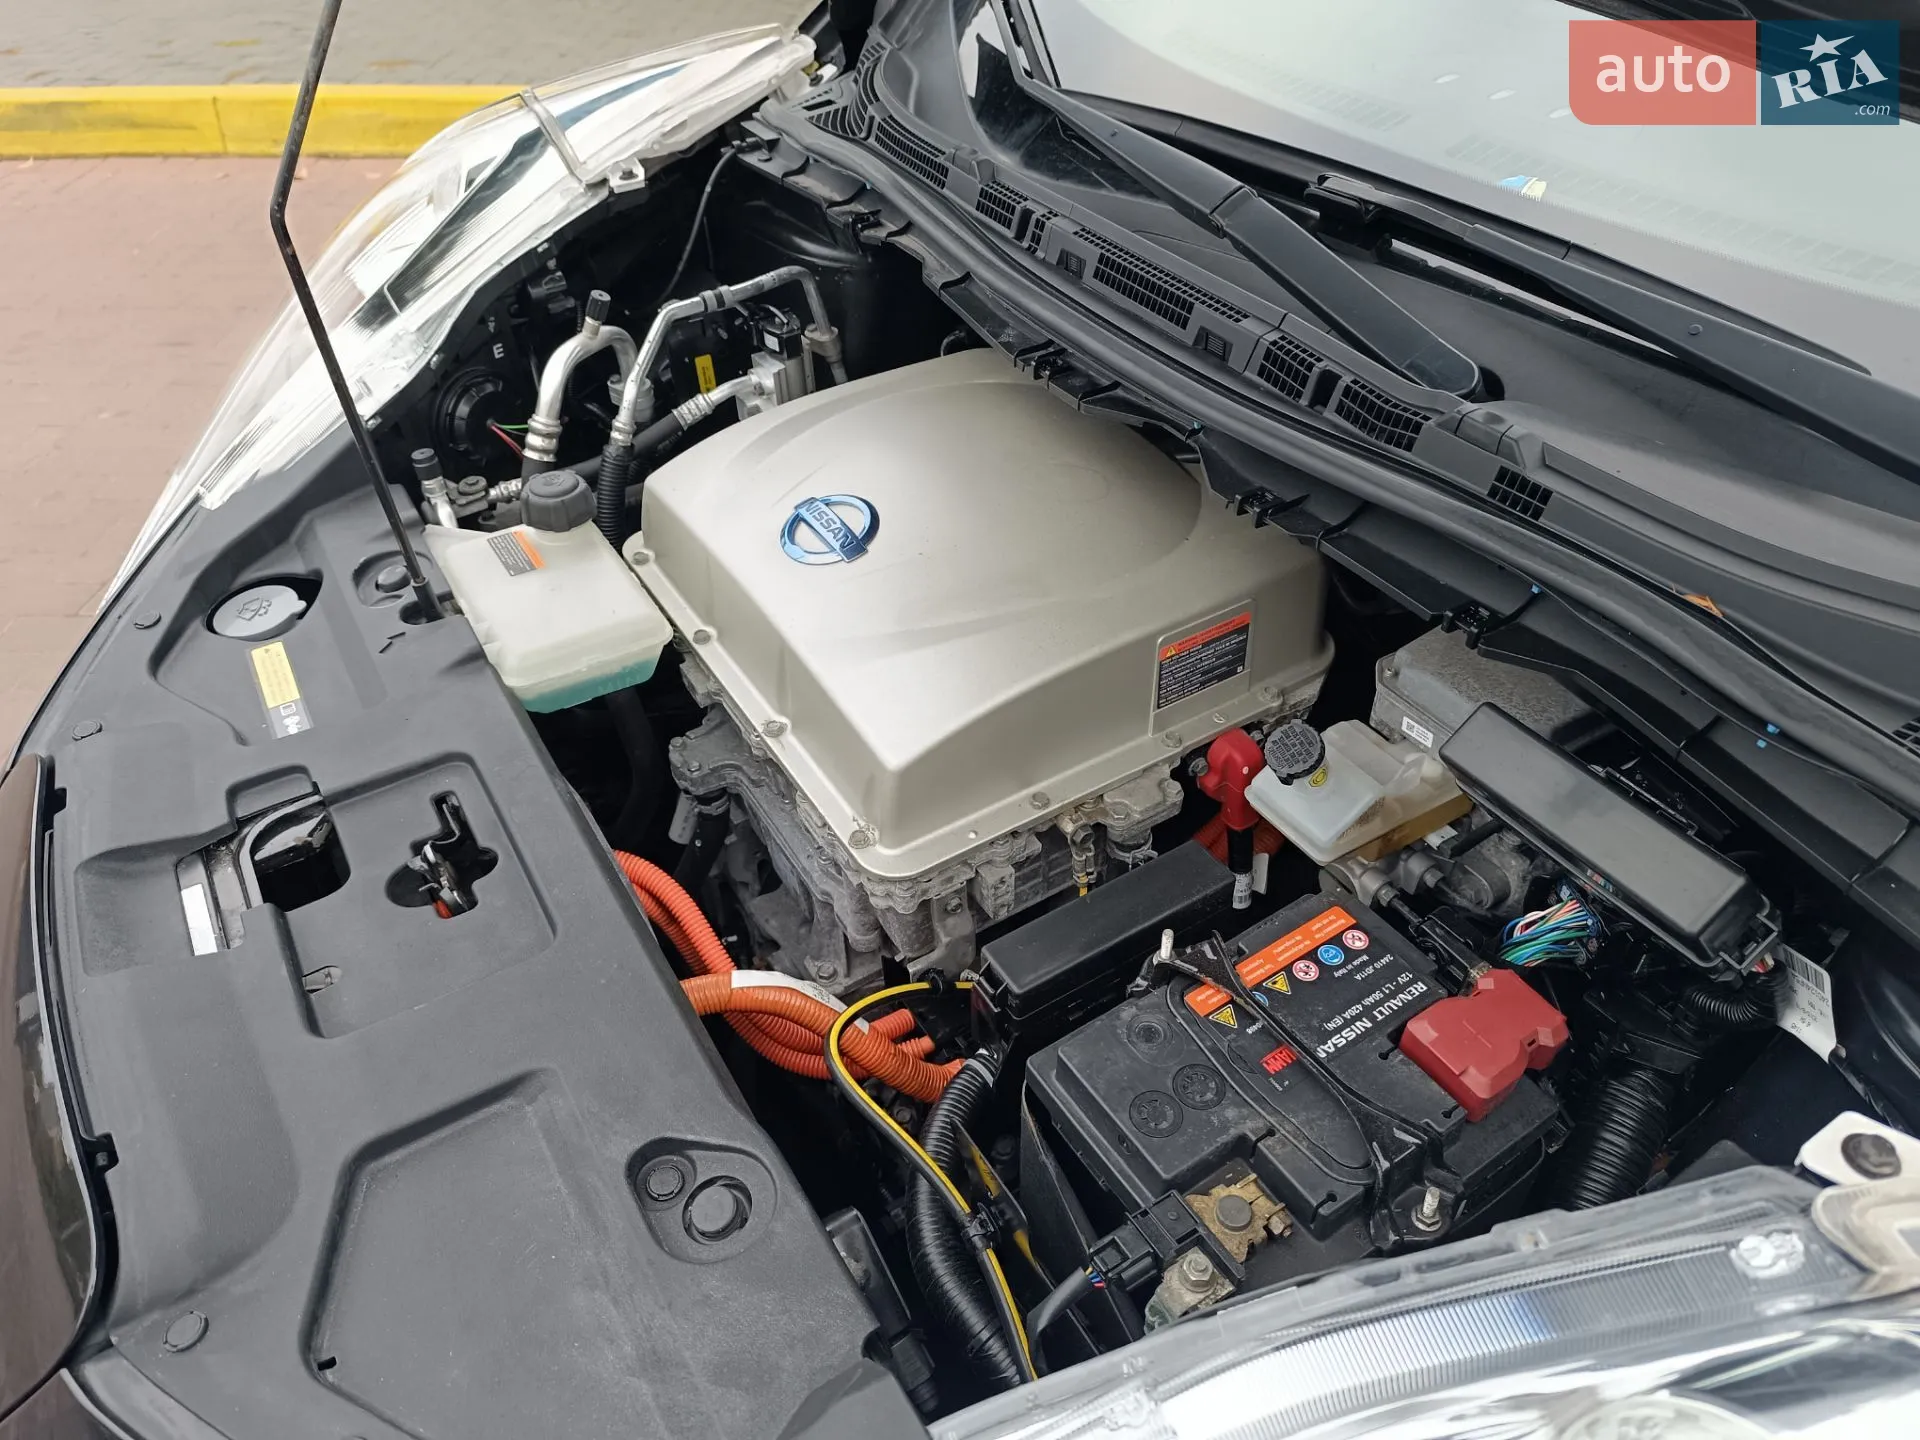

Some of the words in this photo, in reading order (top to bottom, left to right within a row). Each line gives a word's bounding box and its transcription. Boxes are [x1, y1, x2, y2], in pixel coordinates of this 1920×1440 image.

[800, 500, 856, 550] NISSAN
[1397, 971, 1413, 985] 12V
[1382, 983, 1395, 994] L1
[1361, 990, 1384, 1006] 50Ah
[1372, 981, 1427, 1021] RENAULT
[1341, 1003, 1364, 1019] 420A
[1323, 1014, 1345, 1031] (EN)
